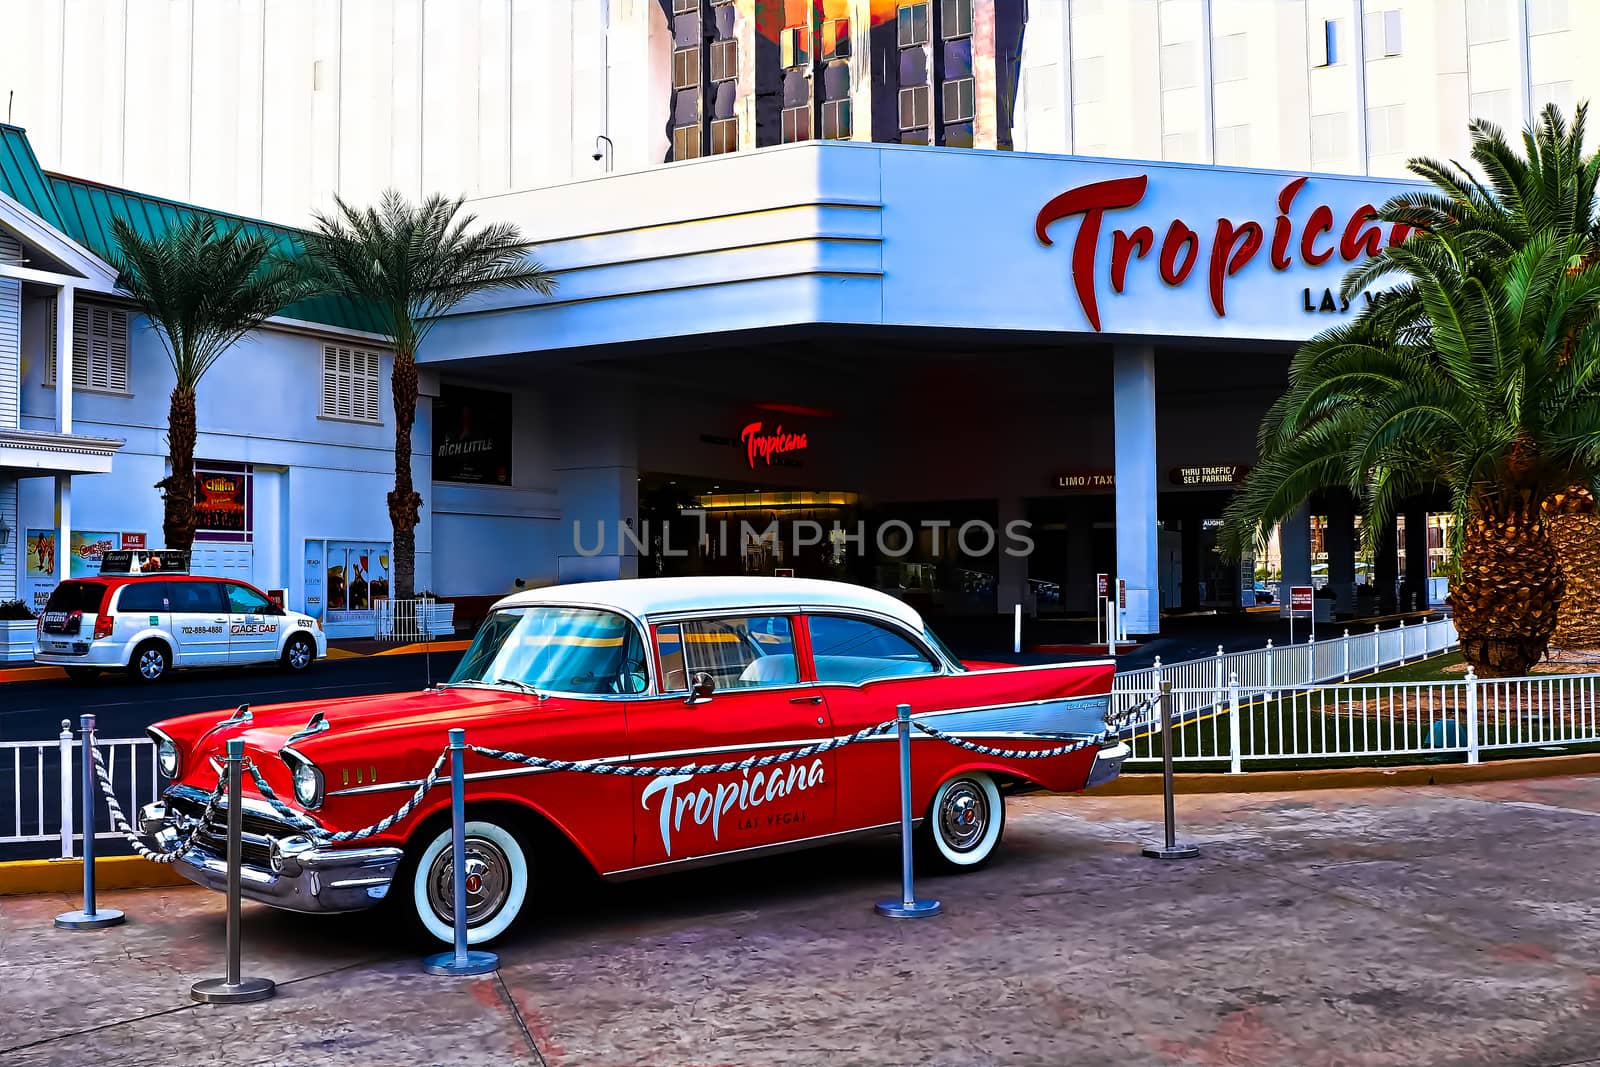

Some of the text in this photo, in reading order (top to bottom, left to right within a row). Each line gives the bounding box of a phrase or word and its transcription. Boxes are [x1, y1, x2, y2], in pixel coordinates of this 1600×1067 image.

[438, 438, 494, 457] RICH LITTLE
[741, 421, 807, 469] Tropicana
[1181, 468, 1200, 477] THRU
[1202, 467, 1231, 475] TRAFFIC
[1059, 476, 1085, 486] LIMO
[1087, 476, 1092, 486] /
[1183, 473, 1233, 484] SELF PARKING
[128, 535, 139, 543] LIVE
[297, 619, 313, 627] 6537
[239, 624, 276, 633] ACE CAB
[641, 756, 825, 857] Tropicana
[737, 810, 806, 830] LAS VEGAS
